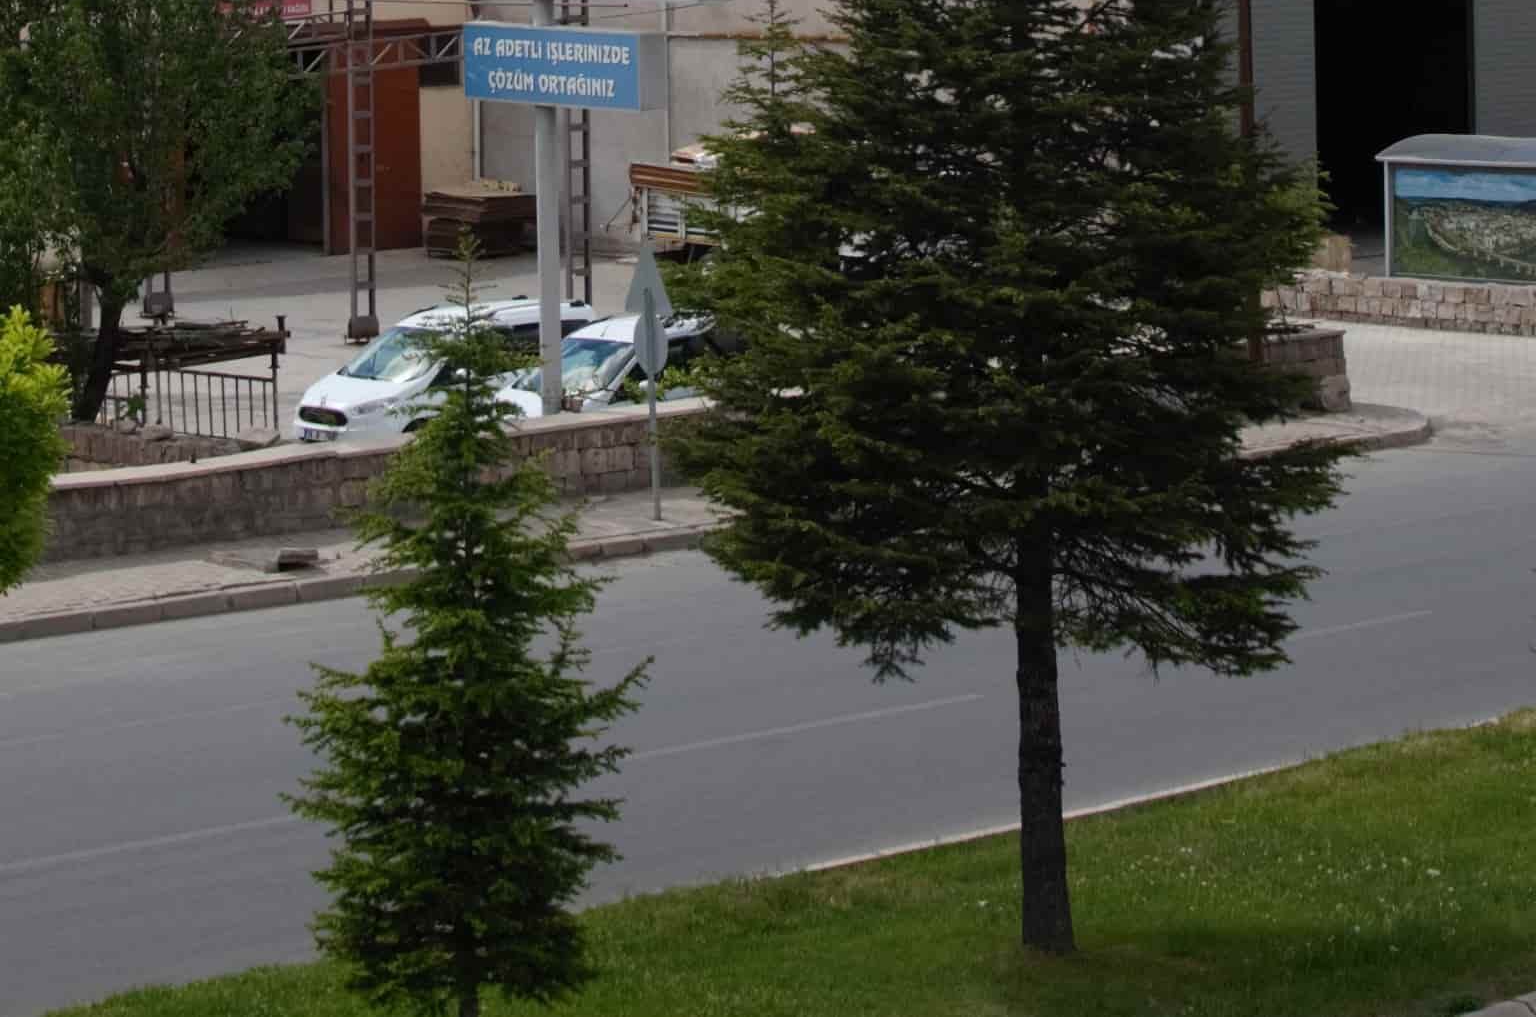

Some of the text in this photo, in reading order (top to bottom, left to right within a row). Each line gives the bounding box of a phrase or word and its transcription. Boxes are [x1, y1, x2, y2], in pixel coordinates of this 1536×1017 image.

[473, 37, 491, 56] AZ
[488, 67, 616, 98] ÇÖZÜM ORTAĞINIZ
